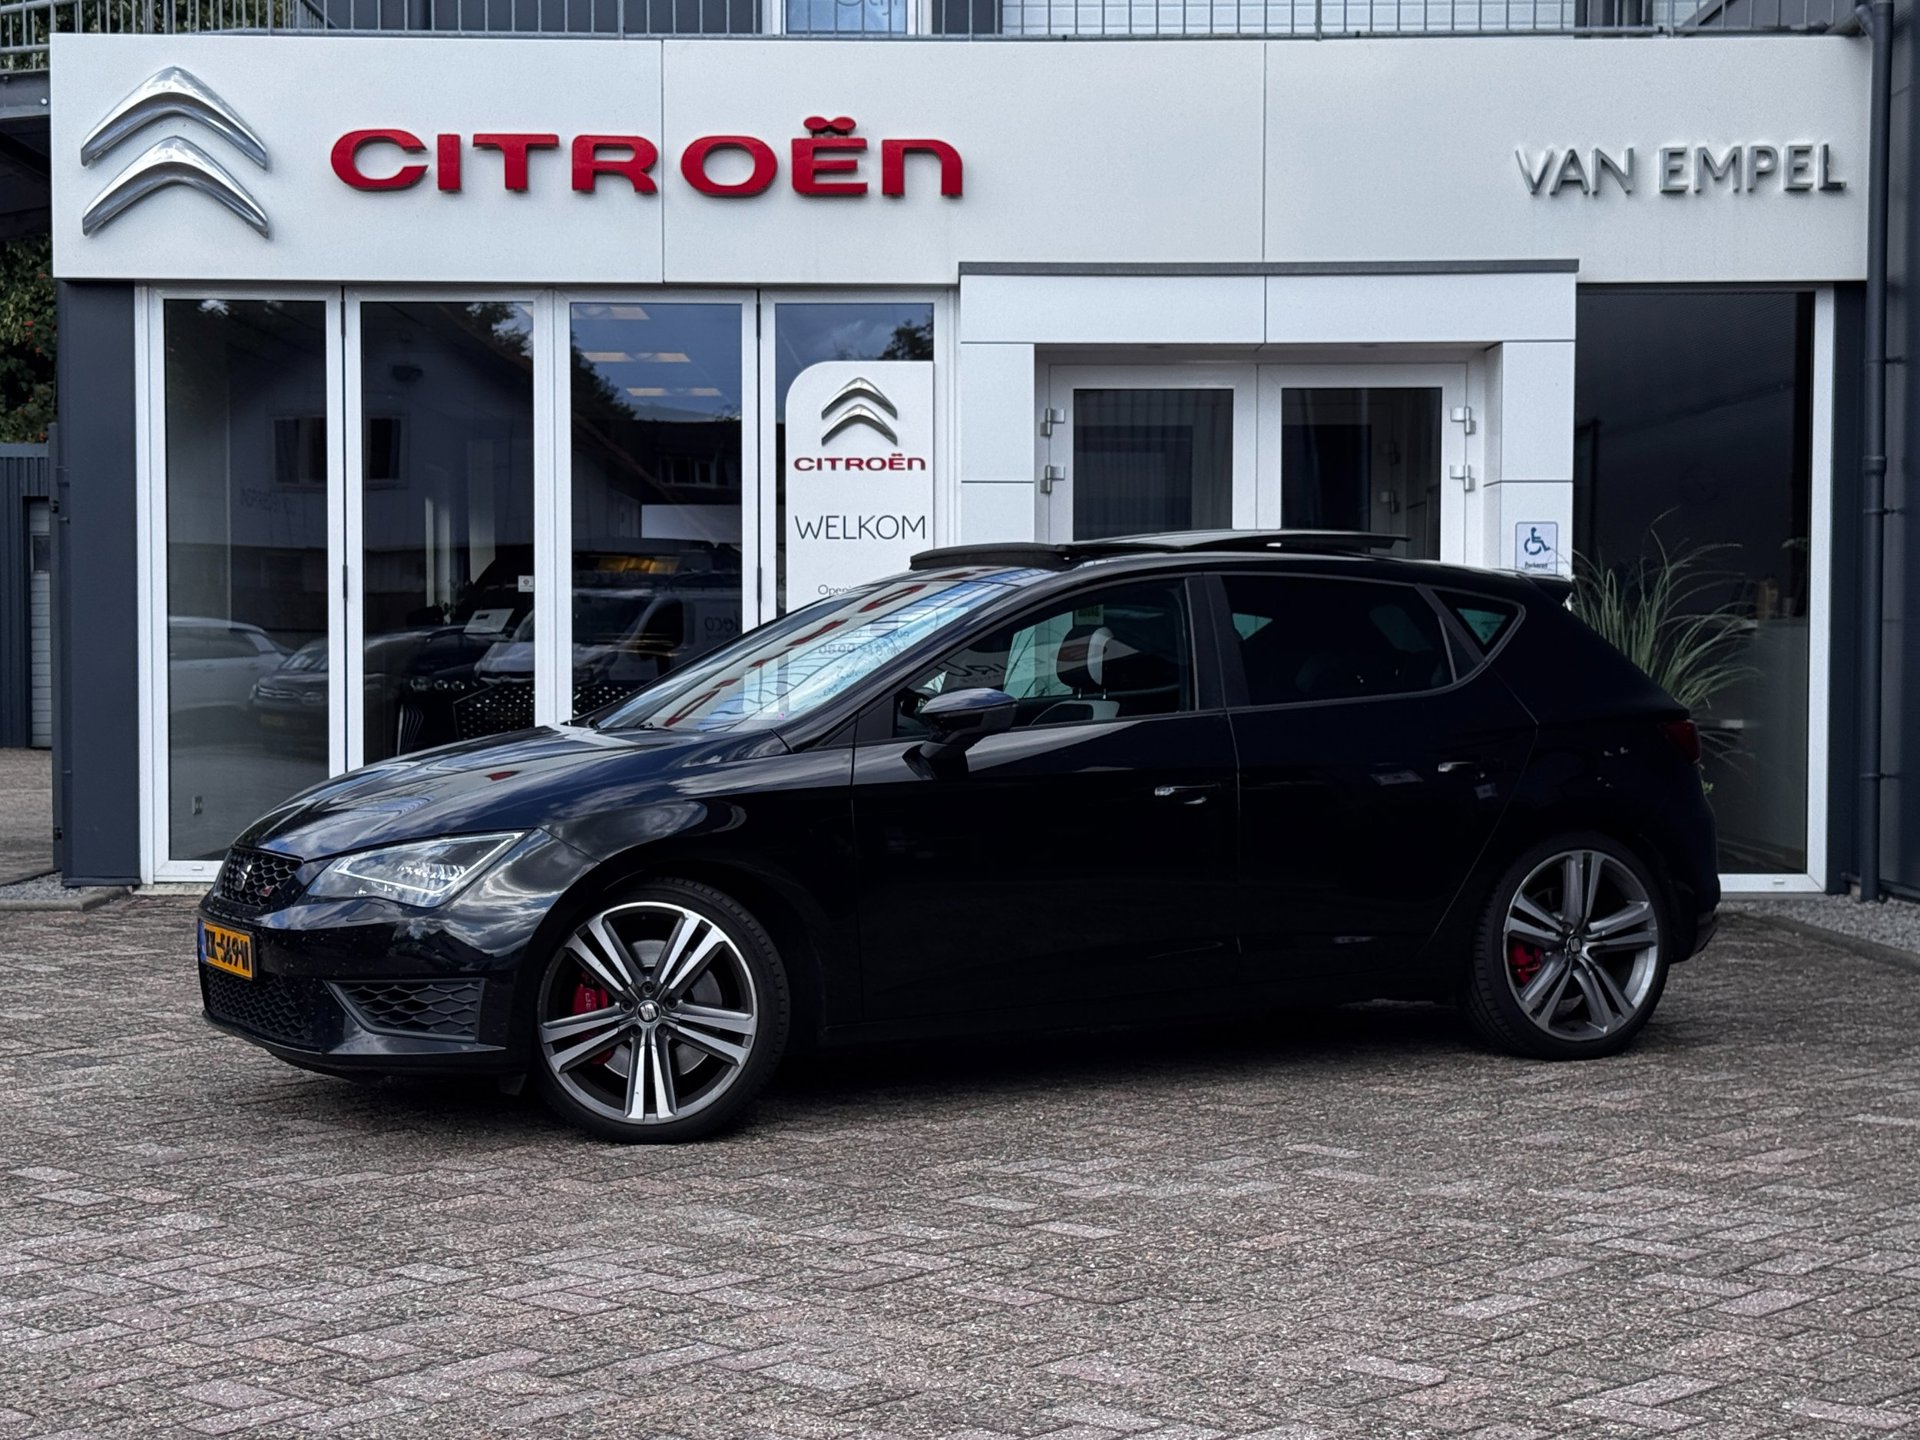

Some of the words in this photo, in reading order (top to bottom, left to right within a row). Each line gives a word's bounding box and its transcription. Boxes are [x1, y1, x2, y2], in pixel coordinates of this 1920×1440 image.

[1515, 147, 1634, 195] VAN
[1659, 144, 1847, 193] EMPEL
[794, 515, 926, 539] WELKOM
